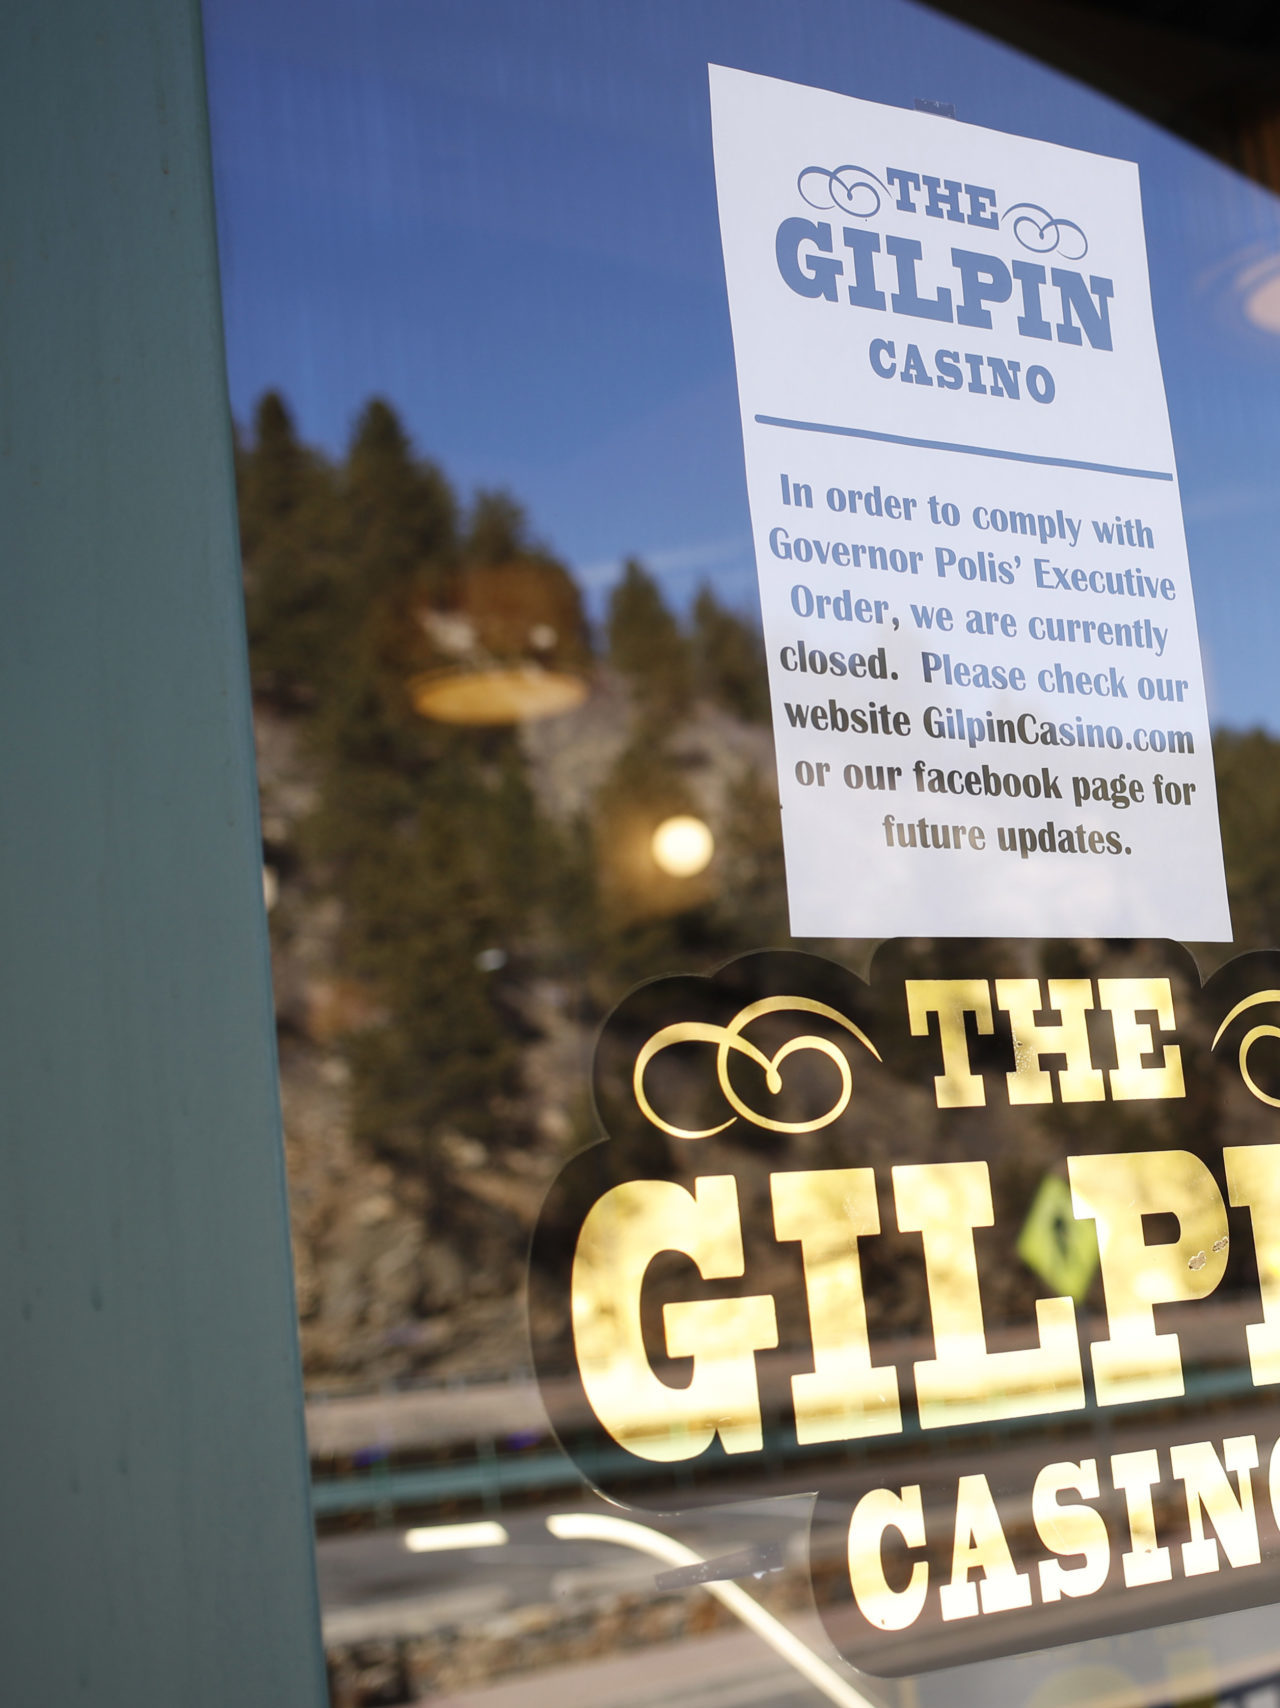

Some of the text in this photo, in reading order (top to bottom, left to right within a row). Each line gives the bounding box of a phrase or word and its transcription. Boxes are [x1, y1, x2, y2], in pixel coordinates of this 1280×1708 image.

[886, 167, 999, 230] THE
[775, 217, 1114, 352] GILPIN
[869, 338, 1056, 404] CASINO
[780, 474, 1155, 549] In order to comply with
[769, 527, 1176, 601] Governor Polis’ Executive
[790, 584, 1168, 656] Order, we are currently
[779, 640, 1189, 702] closed. Please check our
[784, 699, 1194, 754] website GilpinCasino.com
[795, 759, 1196, 809] or our facebook page for
[882, 814, 1132, 858] future updates.
[904, 977, 1187, 1109] THE
